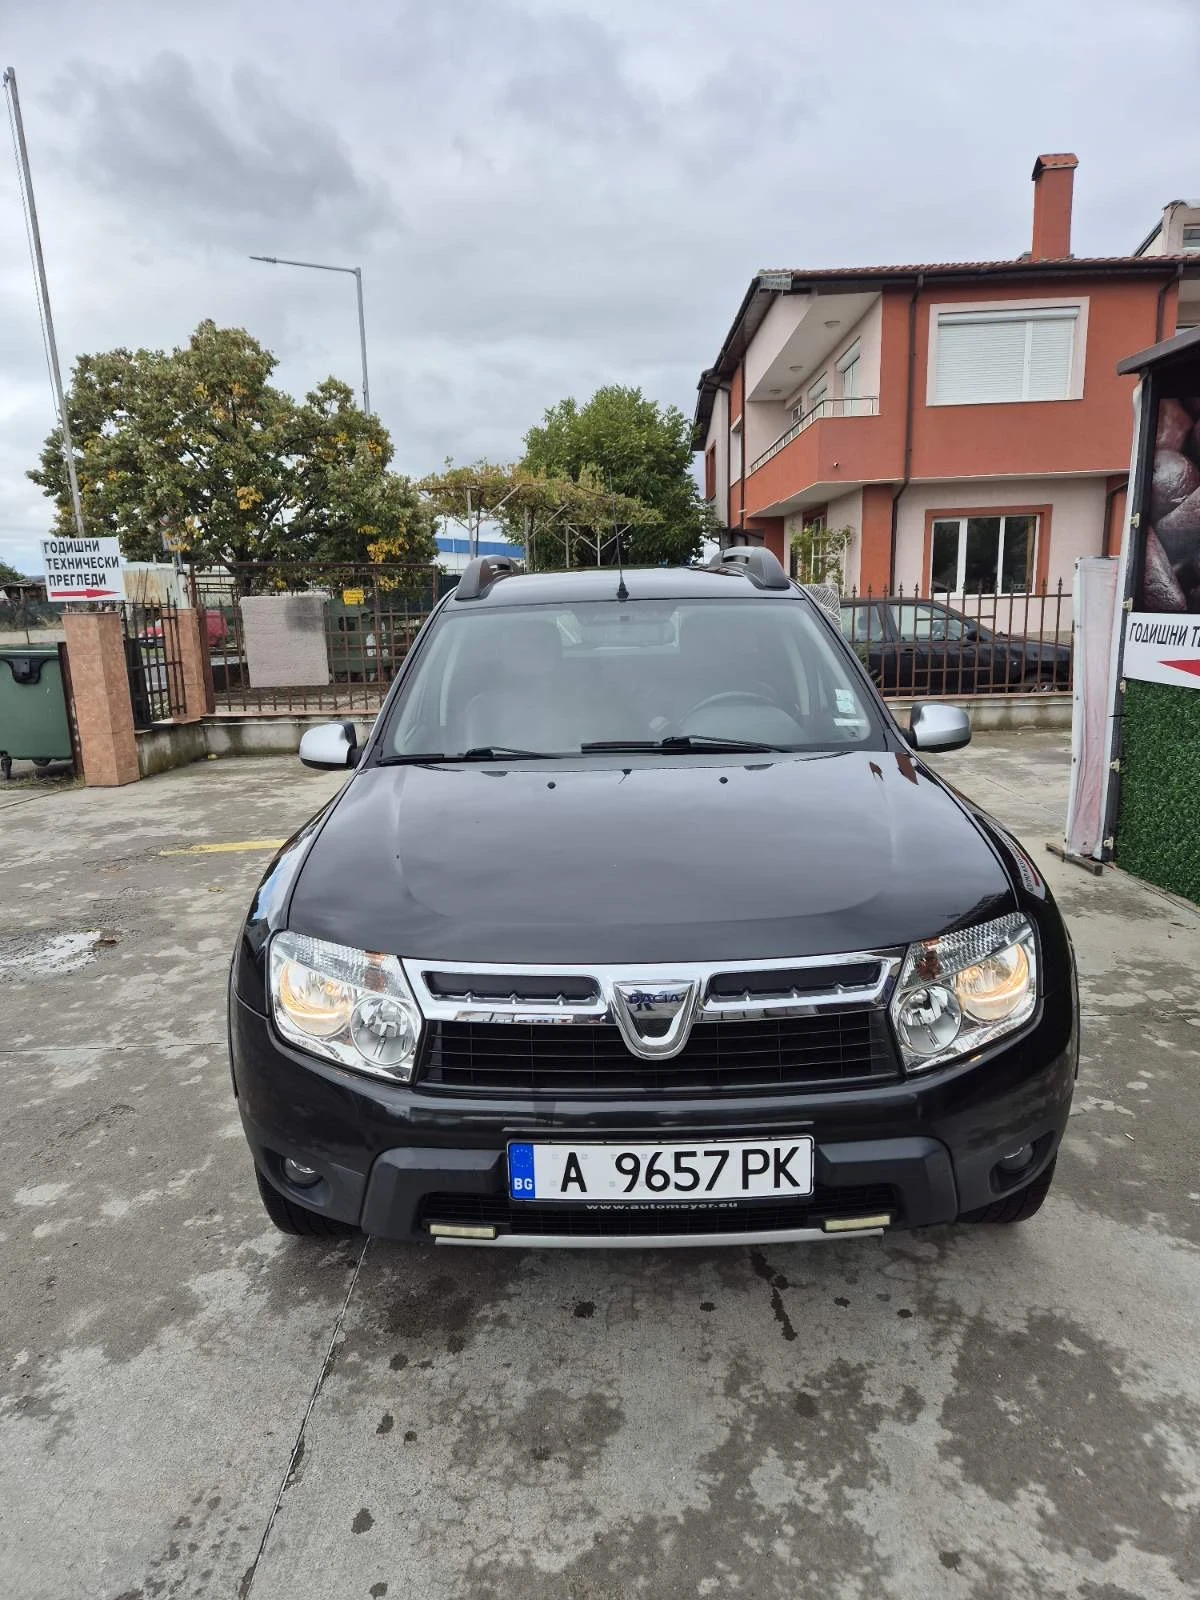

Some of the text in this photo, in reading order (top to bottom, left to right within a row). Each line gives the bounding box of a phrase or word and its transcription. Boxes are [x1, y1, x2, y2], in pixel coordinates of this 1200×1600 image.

[43, 540, 100, 555] ГОДИШНИ
[46, 556, 119, 570] ТЕХНИЧЕСКИ
[48, 573, 107, 587] ПРЕГЛЕДИ
[1129, 622, 1188, 646] ГОДИШНИ
[629, 993, 680, 1004] DACIA
[560, 1146, 801, 1192] A 9657 PK
[513, 1178, 533, 1190] BG
[586, 1202, 738, 1210] www.automeyer.eu
